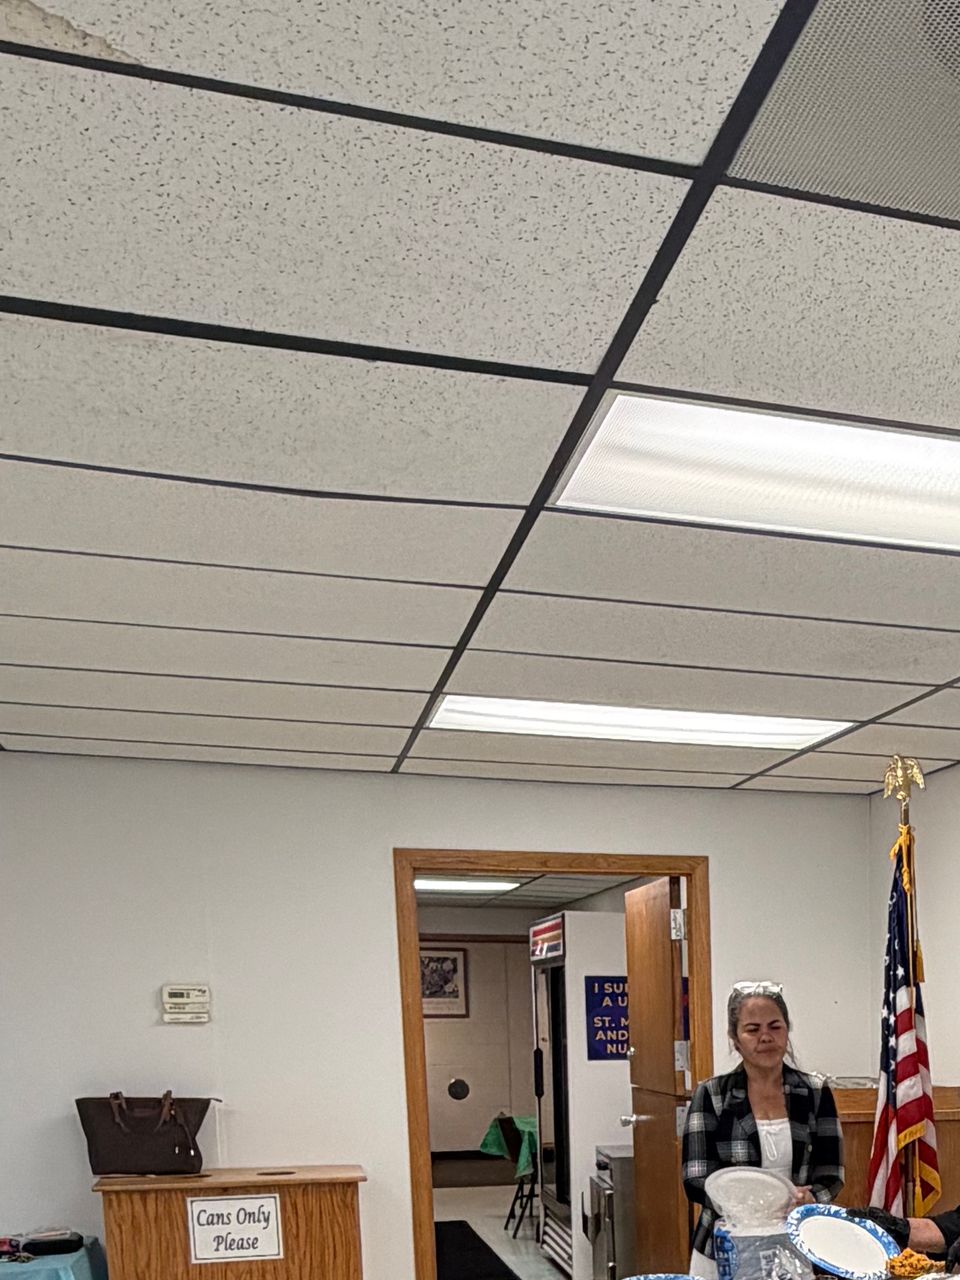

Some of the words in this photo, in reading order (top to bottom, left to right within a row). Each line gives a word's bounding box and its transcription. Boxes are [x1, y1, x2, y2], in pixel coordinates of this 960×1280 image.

[594, 983, 599, 994] I
[602, 996, 613, 1007] A
[593, 1017, 616, 1028] ST.
[595, 1030, 629, 1041] AND
[197, 1209, 232, 1227] Cans
[236, 1204, 271, 1230] Only
[213, 1232, 259, 1252] Please
